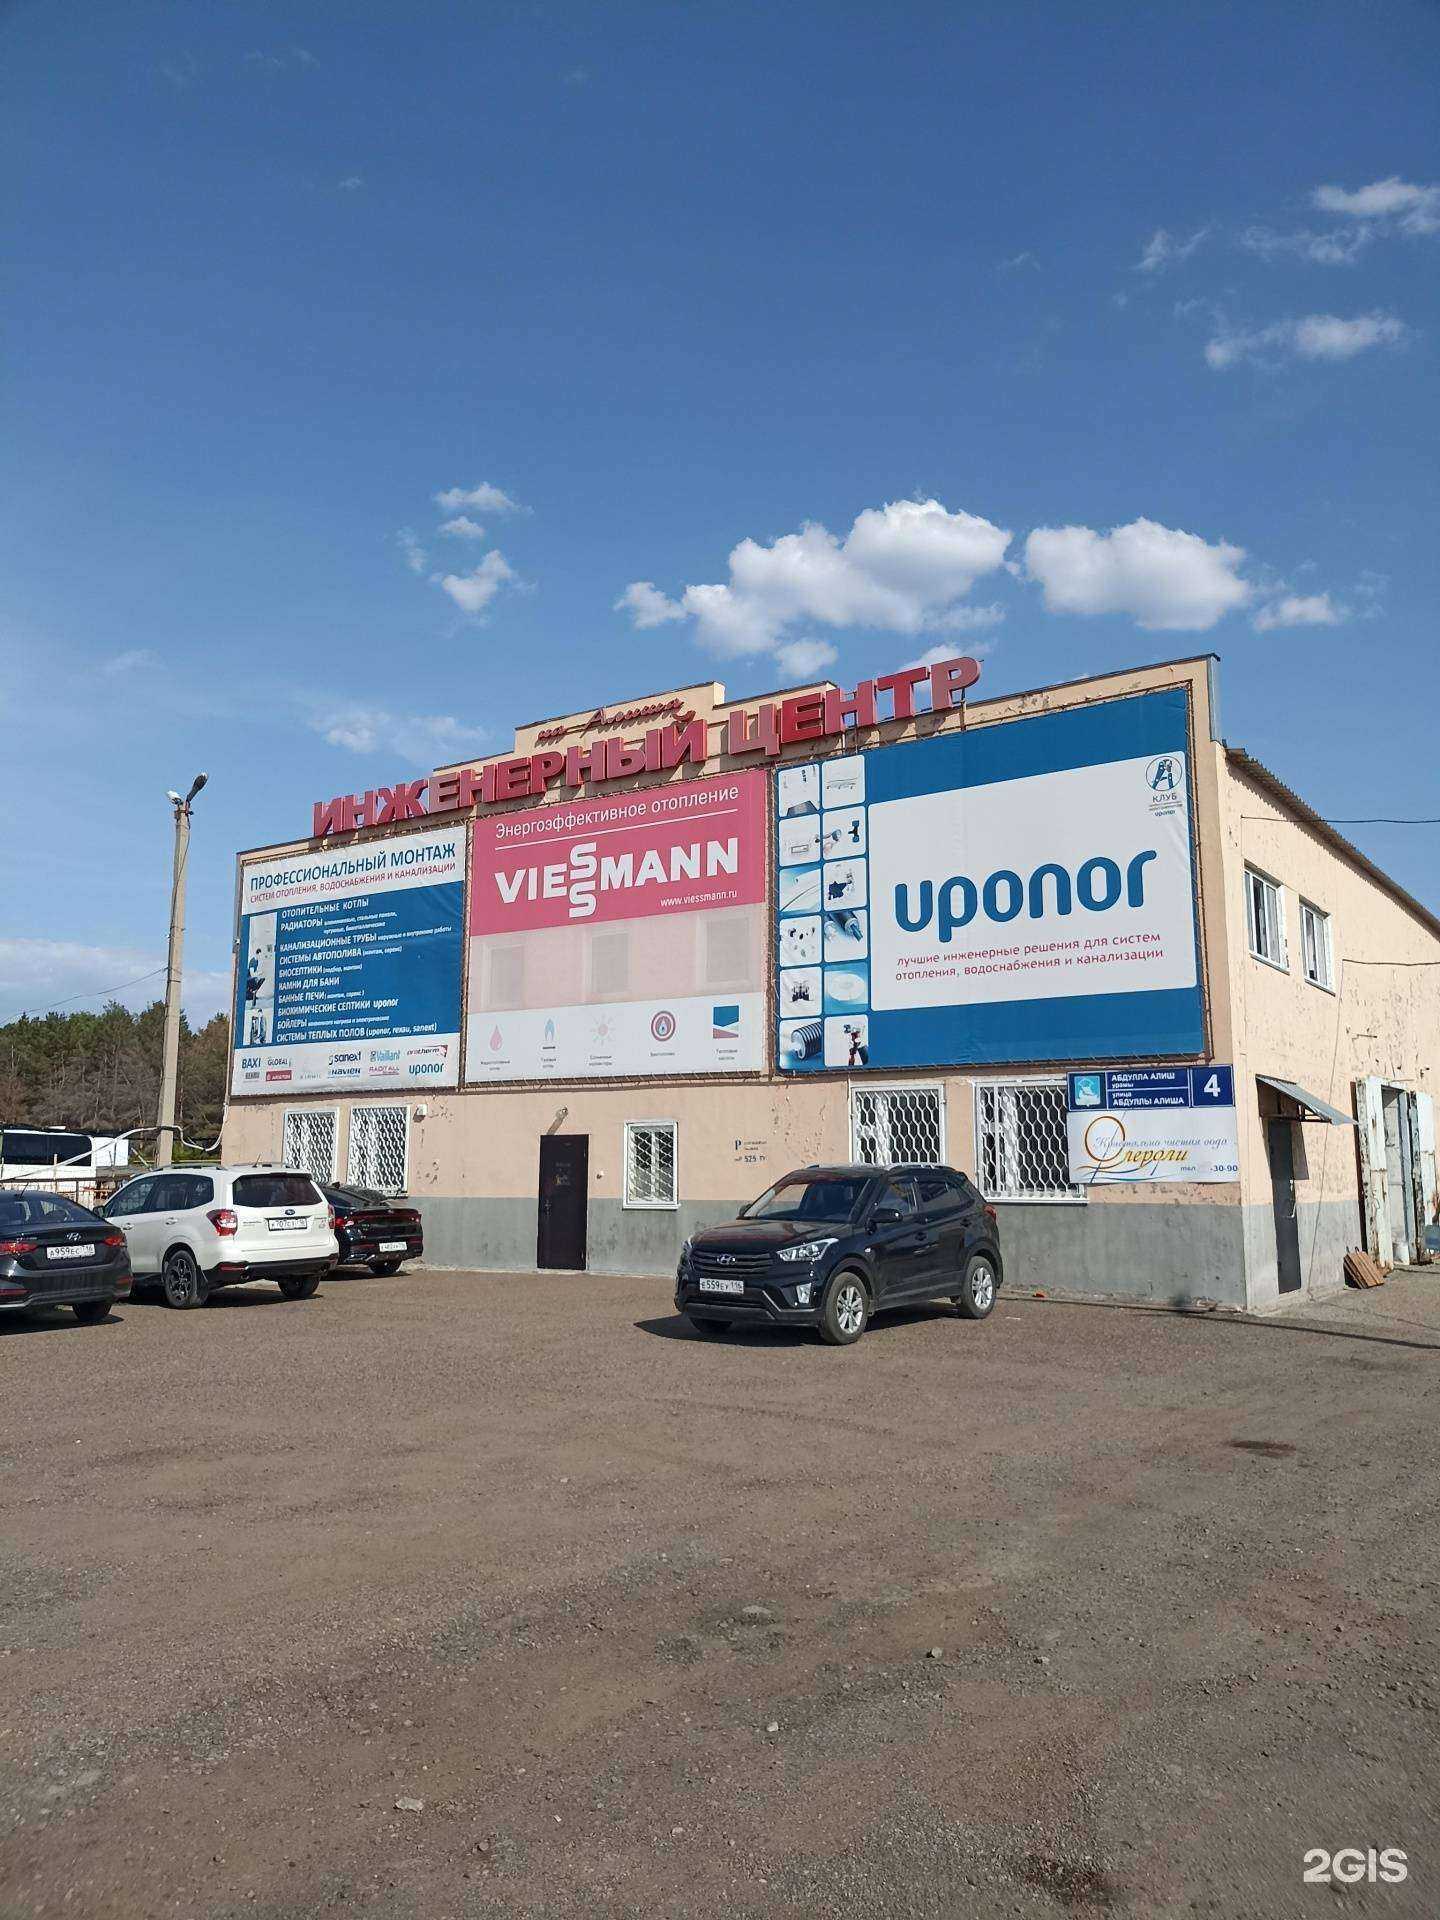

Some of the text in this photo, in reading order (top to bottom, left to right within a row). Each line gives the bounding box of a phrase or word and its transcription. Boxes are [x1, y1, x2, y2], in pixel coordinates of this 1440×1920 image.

[313, 656, 981, 838] ИНЖЕНЕРНЫЙ ЦЕНТР
[1153, 793, 1177, 803] КЛУБ
[496, 786, 739, 839] Энергоэффективное отопление
[250, 843, 456, 891] ПРОФЕССИОНАЛЬНЫЙ МОНТАЖ
[250, 891, 275, 903] СИСТЕМ
[320, 873, 386, 891] ВОДОСНАБЖЕНИЯ
[387, 872, 393, 880] И
[395, 863, 456, 878] КАНАЛИЗАЦИИ
[494, 837, 738, 918] VIESSMANN
[660, 889, 738, 907] www.viessmann.ru
[895, 850, 1157, 943] uponor
[282, 898, 369, 919] ОТОПИТЕЛЬНЫЕ КОТЛЫ
[280, 918, 323, 931] РАДИАТОРЫ
[280, 936, 351, 952] КАНАЛИЗАЦИОННЫЕ
[353, 933, 377, 943] ТРУБЫ
[897, 932, 1161, 967] лучшие инженерные решения для систем
[279, 953, 311, 965] СИСТЕМЫ
[312, 948, 361, 961] АВТОПОЛИВА
[895, 949, 1164, 981] отопления, водоснабжения и канализации
[279, 965, 323, 978] БИОСЕПТИКИ
[279, 977, 340, 990] КАМНИ ДЛЯ БАНИ
[278, 992, 304, 1004] БАННЫЕ
[305, 991, 325, 1000] ПЕЧИ
[278, 1003, 337, 1017] БИОХИМИЧЕСКИЕ
[337, 1000, 371, 1011] СЕПТИКИ
[277, 1019, 308, 1030] БОЙЛЕРЫ
[276, 1032, 307, 1042] СИСТЕМЫ
[308, 1029, 338, 1040] ТЕПЛЫХ
[338, 1027, 365, 1038] ПОЛОВ
[241, 1058, 261, 1069] BAXI
[334, 1051, 361, 1062] sanext
[408, 1063, 444, 1076] uponor
[1111, 1072, 1175, 1082] АБДУЛЛА АЛИШ
[1203, 1074, 1221, 1098] 4
[1112, 1097, 1184, 1107] АБДУЛЛЫ АЛИША
